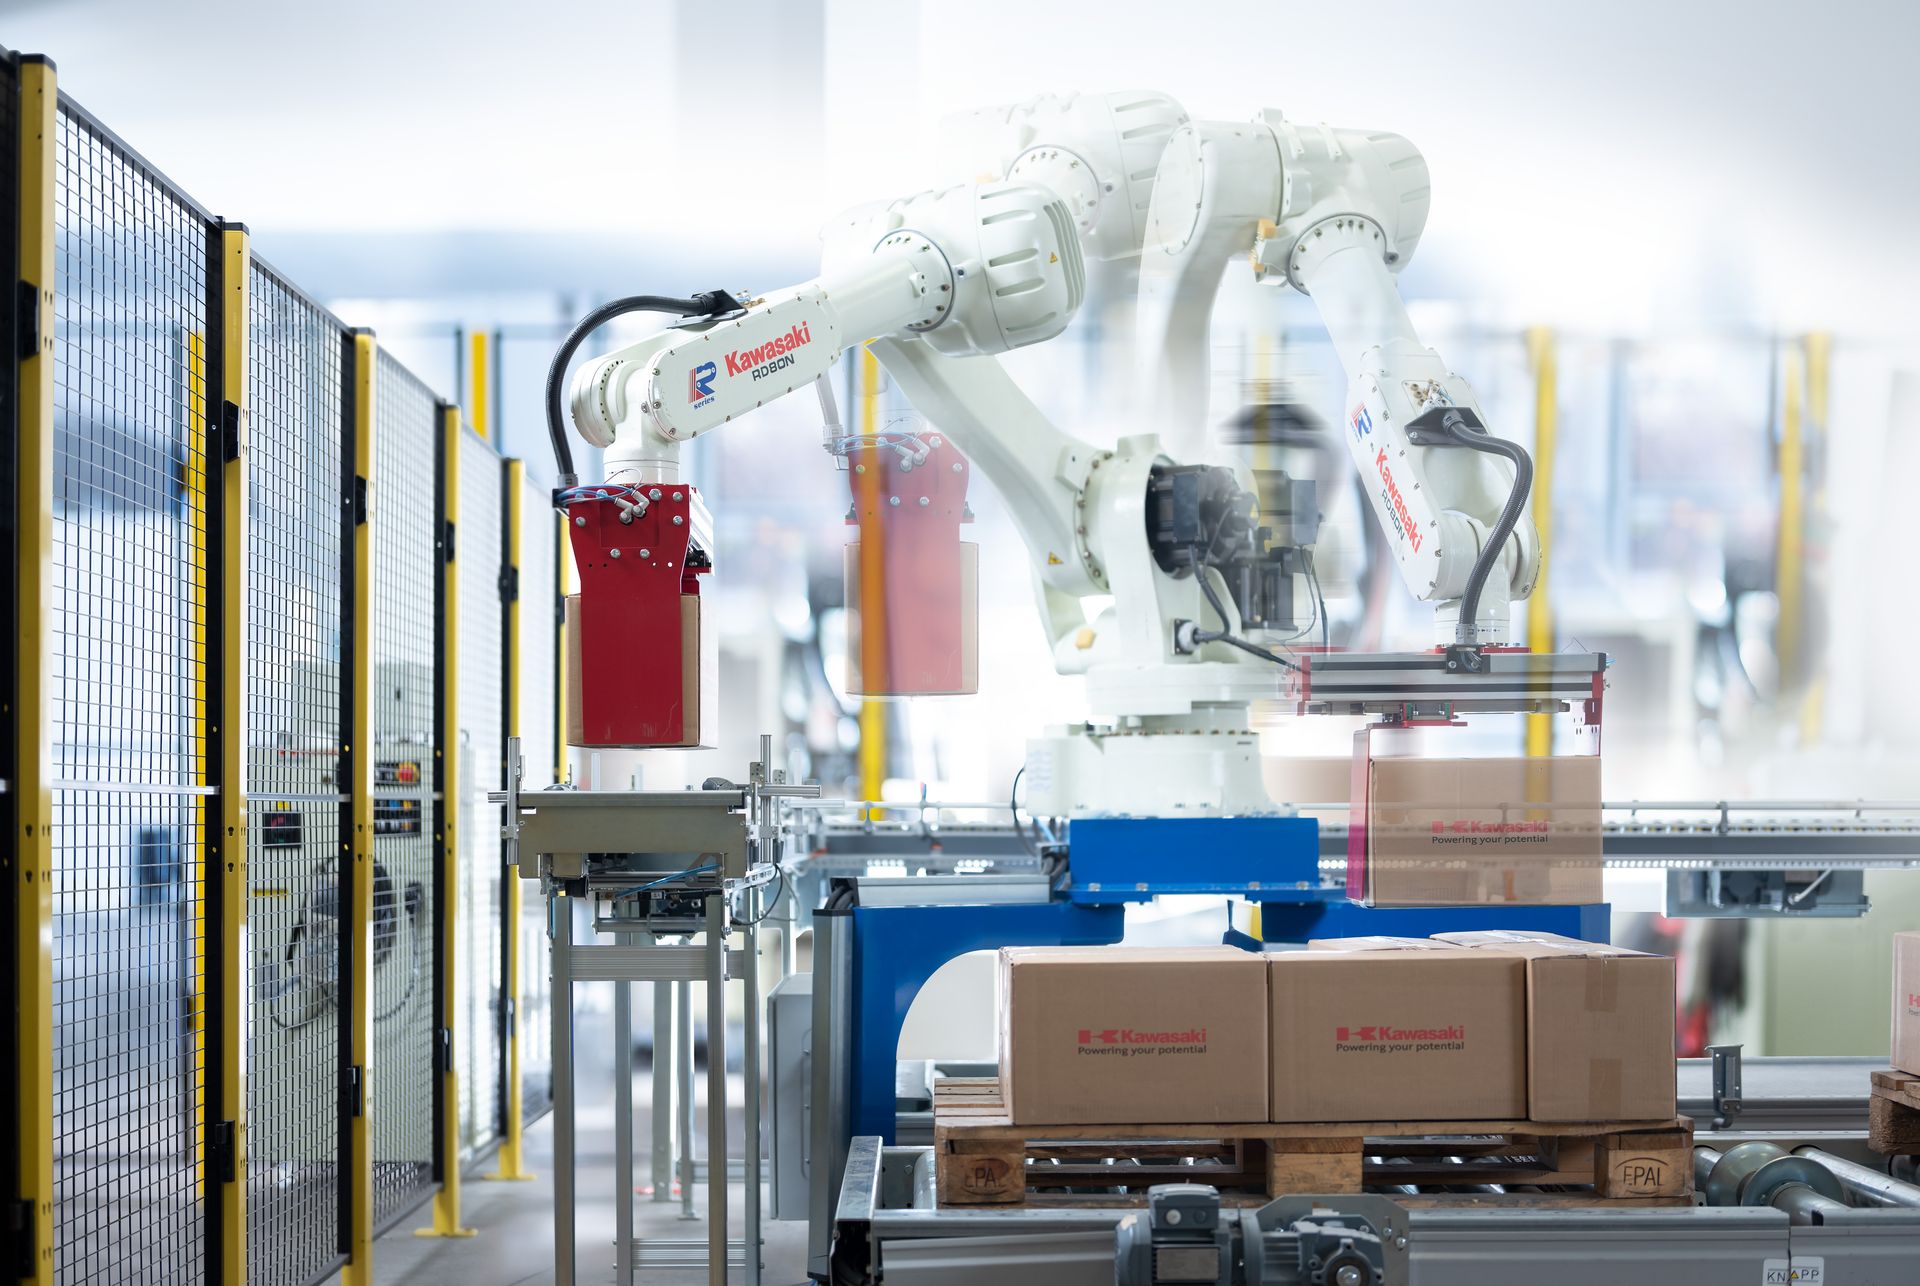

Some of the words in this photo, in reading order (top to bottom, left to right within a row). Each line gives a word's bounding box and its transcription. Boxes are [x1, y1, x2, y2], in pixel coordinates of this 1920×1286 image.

[724, 320, 811, 378] Kawasaki
[752, 353, 795, 382] RD80N
[693, 396, 715, 410] series
[1375, 447, 1424, 554] Kawasaki
[1470, 819, 1548, 833] Kawasaki
[1431, 835, 1477, 845] Powering
[1479, 836, 1501, 846] your
[1504, 834, 1548, 845] potential
[1120, 1028, 1207, 1044] Kawasaki
[1378, 1025, 1465, 1041] Kawasaki
[1077, 1045, 1129, 1057] Powering
[1130, 1046, 1155, 1057] your
[1158, 1044, 1207, 1056] potential
[1335, 1042, 1387, 1054] Powering
[1388, 1043, 1413, 1054] your
[1416, 1041, 1465, 1053] potential
[1623, 1165, 1665, 1187] EPAL
[1767, 1269, 1820, 1283] KNAPP
